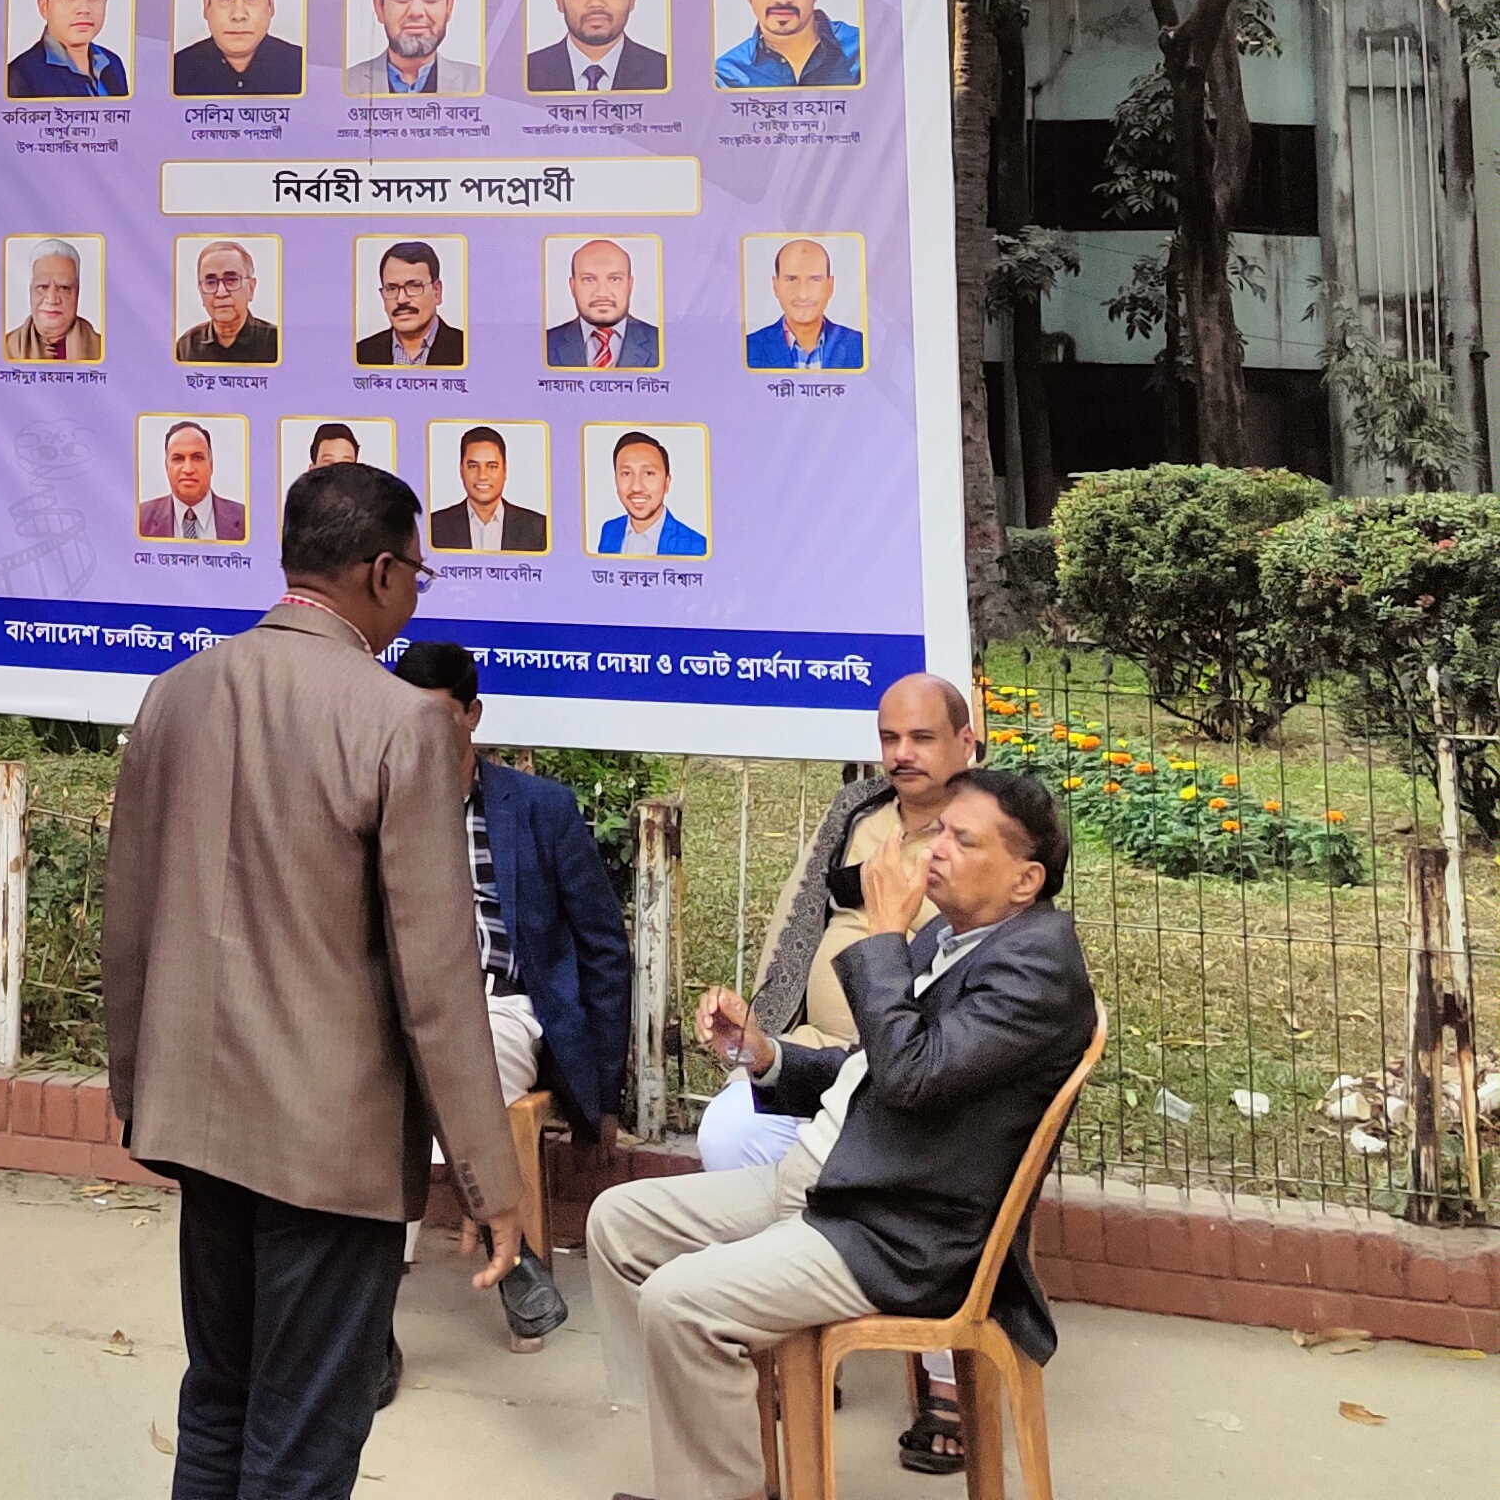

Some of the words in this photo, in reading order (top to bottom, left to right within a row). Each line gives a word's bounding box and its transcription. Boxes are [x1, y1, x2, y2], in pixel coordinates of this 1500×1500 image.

[54, 106, 100, 124] ইসলাম
[103, 109, 131, 124] রানা
[184, 103, 233, 124] সেলিম
[238, 106, 291, 124] আজম
[407, 102, 441, 122] আলী
[444, 104, 483, 124] বাবলু
[546, 104, 589, 122] বন্ধন
[593, 99, 643, 121] বিশ্বাস
[731, 97, 788, 119] সাইফুর
[793, 99, 847, 117] রহমান
[272, 169, 363, 203] নির্বাহী
[368, 177, 452, 204] সদস্য
[459, 167, 575, 207] পদপ্রার্থী
[486, 563, 542, 582] আবেদীন
[618, 570, 660, 587] বুলবুল
[662, 568, 704, 587] বিশ্বাস
[4, 619, 100, 647] বাংলাদেশ
[102, 623, 175, 652] চলচ্চিত্র
[494, 647, 592, 673] সদস্যদের
[597, 652, 650, 675] দোয়া
[656, 657, 673, 674] ও
[679, 650, 732, 678] ভোট
[736, 652, 801, 681] প্রার্থনা
[807, 654, 873, 687] করছি
